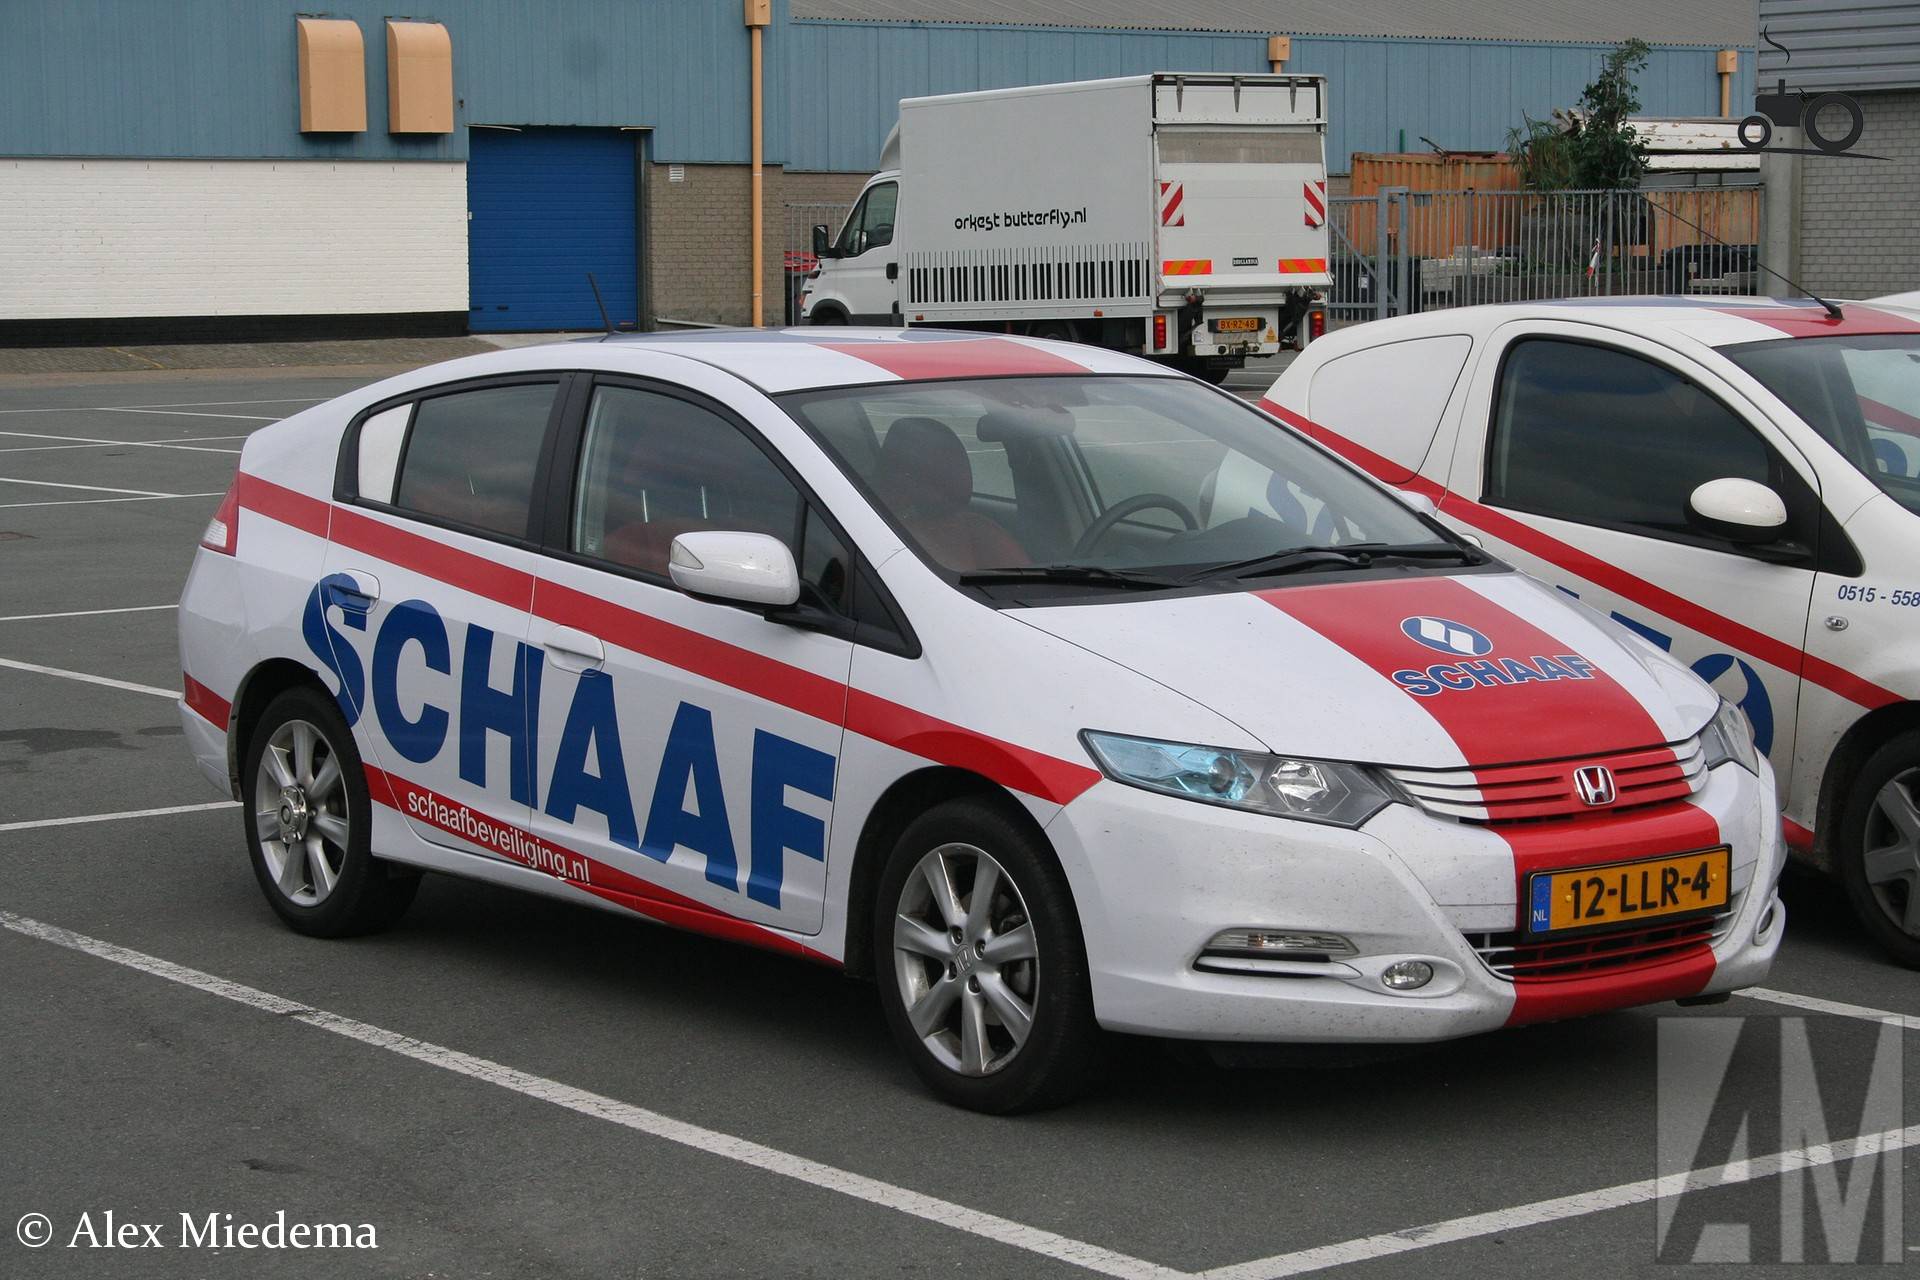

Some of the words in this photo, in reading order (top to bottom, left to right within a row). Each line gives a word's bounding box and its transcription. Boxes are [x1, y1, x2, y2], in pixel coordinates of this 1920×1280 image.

[954, 213, 1000, 232] orkest
[1004, 207, 1087, 229] butterfly.nl
[1220, 320, 1255, 329] BX-RZ-48
[1838, 585, 1876, 603] 0515
[1392, 655, 1596, 697] SCHAAF
[302, 573, 837, 910] SCHAAF
[408, 791, 591, 886] schaafbeveiliging.nl
[1570, 861, 1711, 920] 12-LLR-4
[1533, 909, 1547, 922] NL
